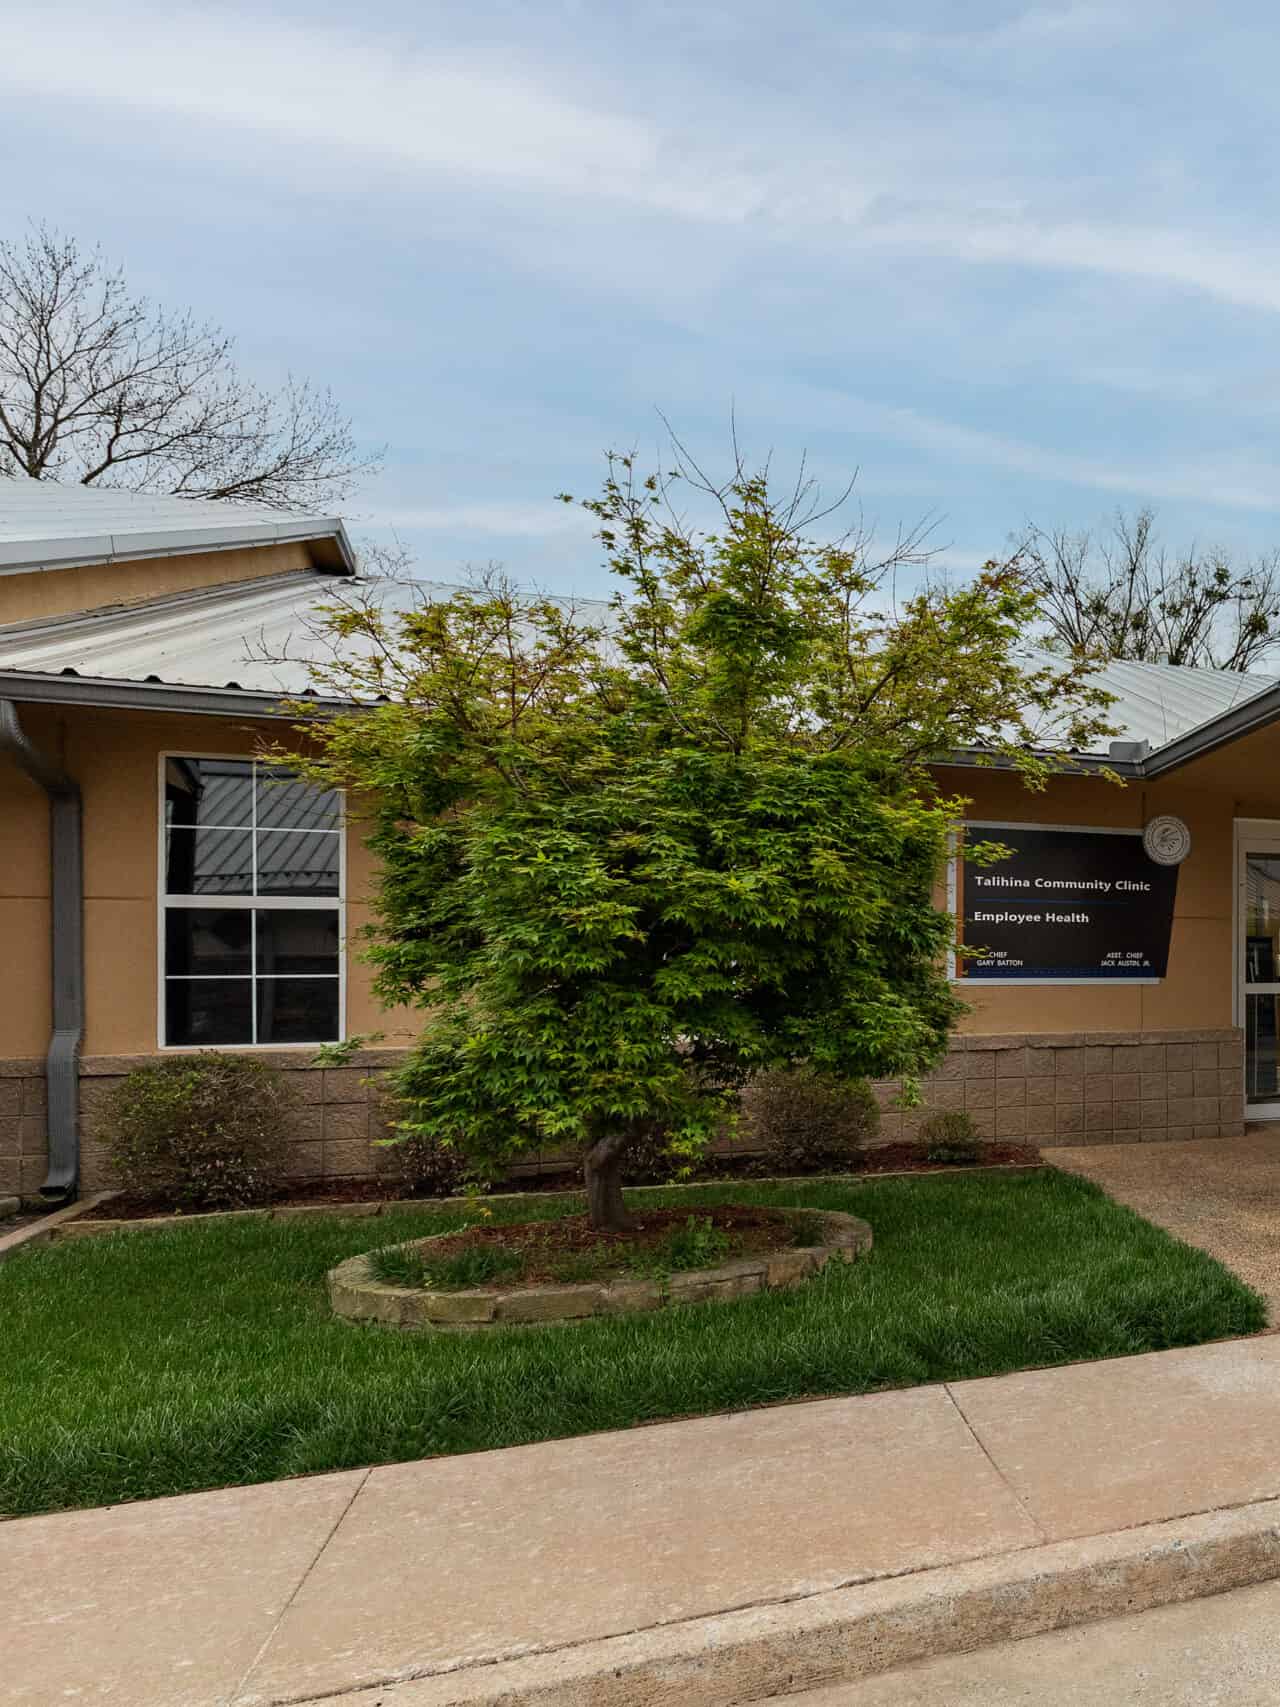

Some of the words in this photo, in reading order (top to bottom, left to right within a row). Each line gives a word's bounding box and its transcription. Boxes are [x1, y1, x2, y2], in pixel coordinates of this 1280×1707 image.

[974, 876, 1031, 888] Talihina
[1034, 878, 1112, 892] Community
[1115, 880, 1151, 892] Clinic
[974, 911, 1041, 925] Employee
[1046, 912, 1089, 923] Health
[989, 951, 1008, 959] CHIEF
[976, 959, 995, 967] GARY
